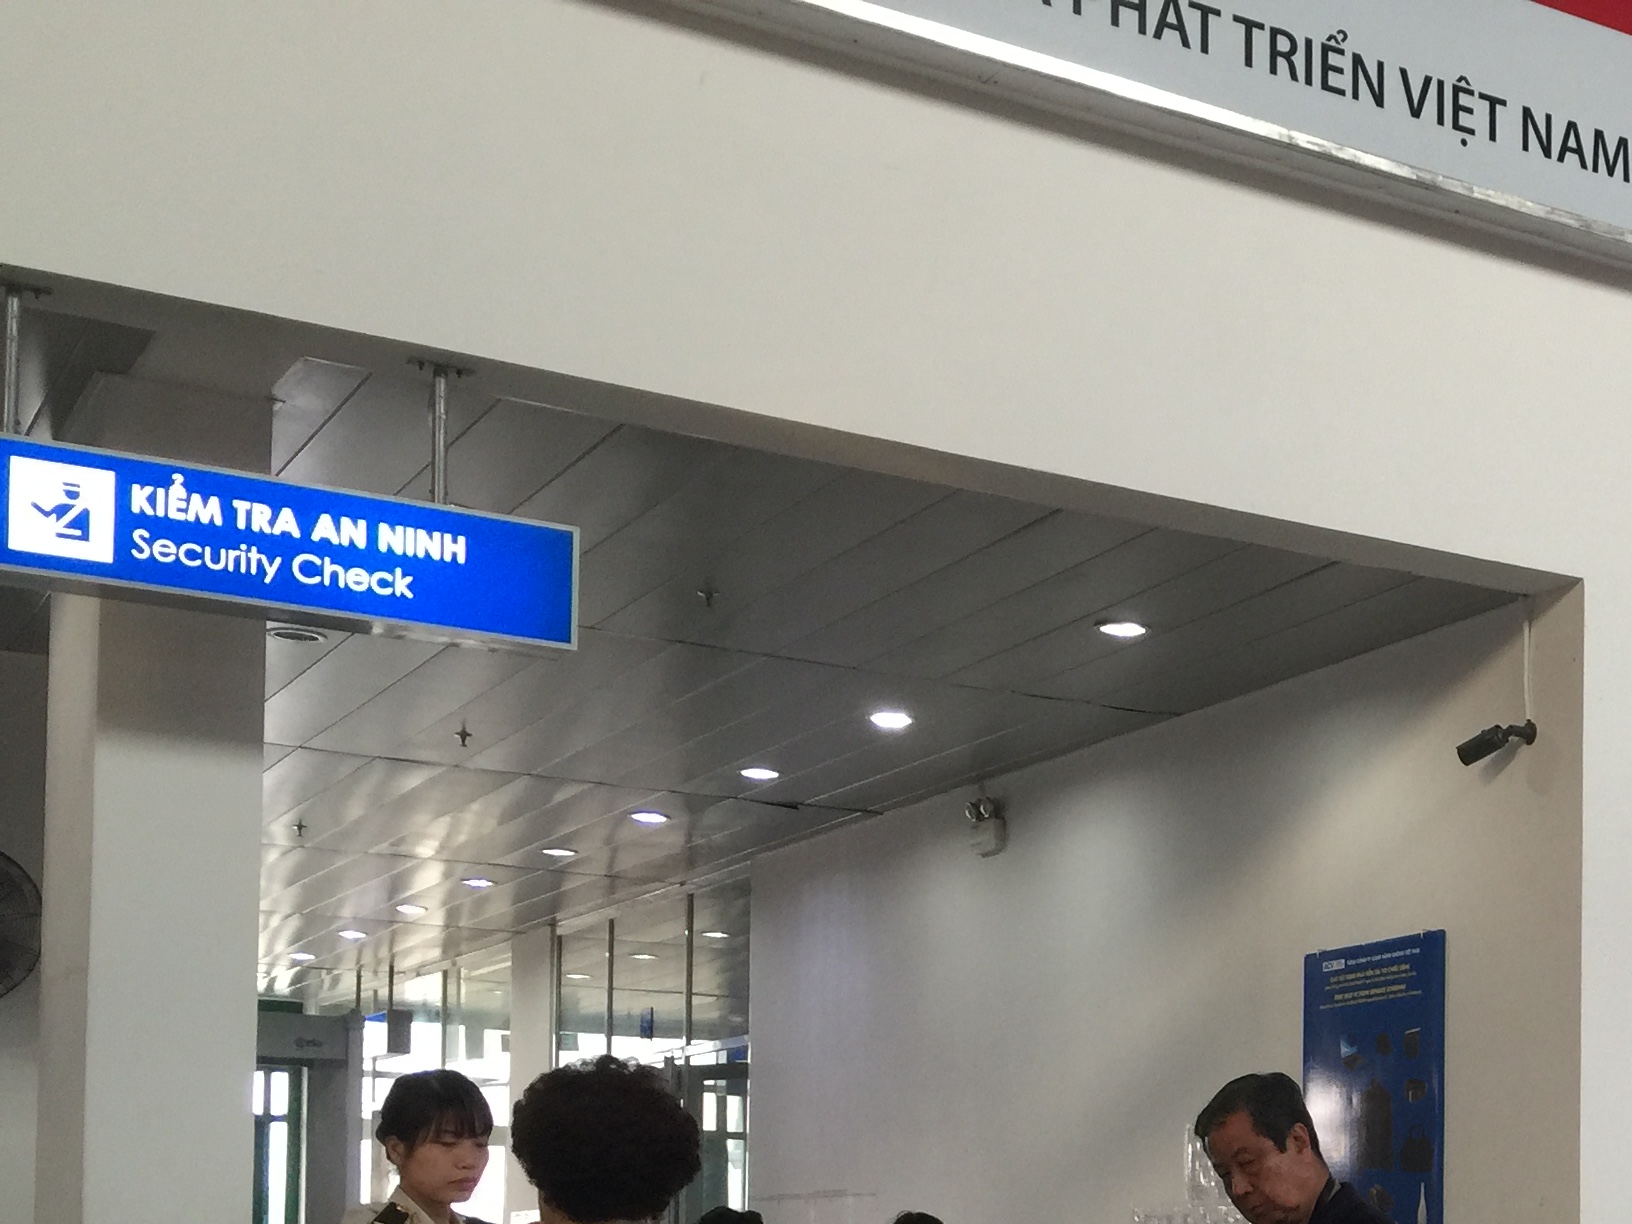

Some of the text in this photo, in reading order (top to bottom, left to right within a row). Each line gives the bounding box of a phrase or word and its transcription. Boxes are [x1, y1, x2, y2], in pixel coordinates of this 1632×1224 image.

[1232, 13, 1385, 109] TRIỂN
[1398, 66, 1508, 148] VIỆT
[1521, 105, 1632, 184] NAM
[131, 473, 467, 564] KIỂM TRA AN NINH
[131, 528, 414, 599] Security Check
